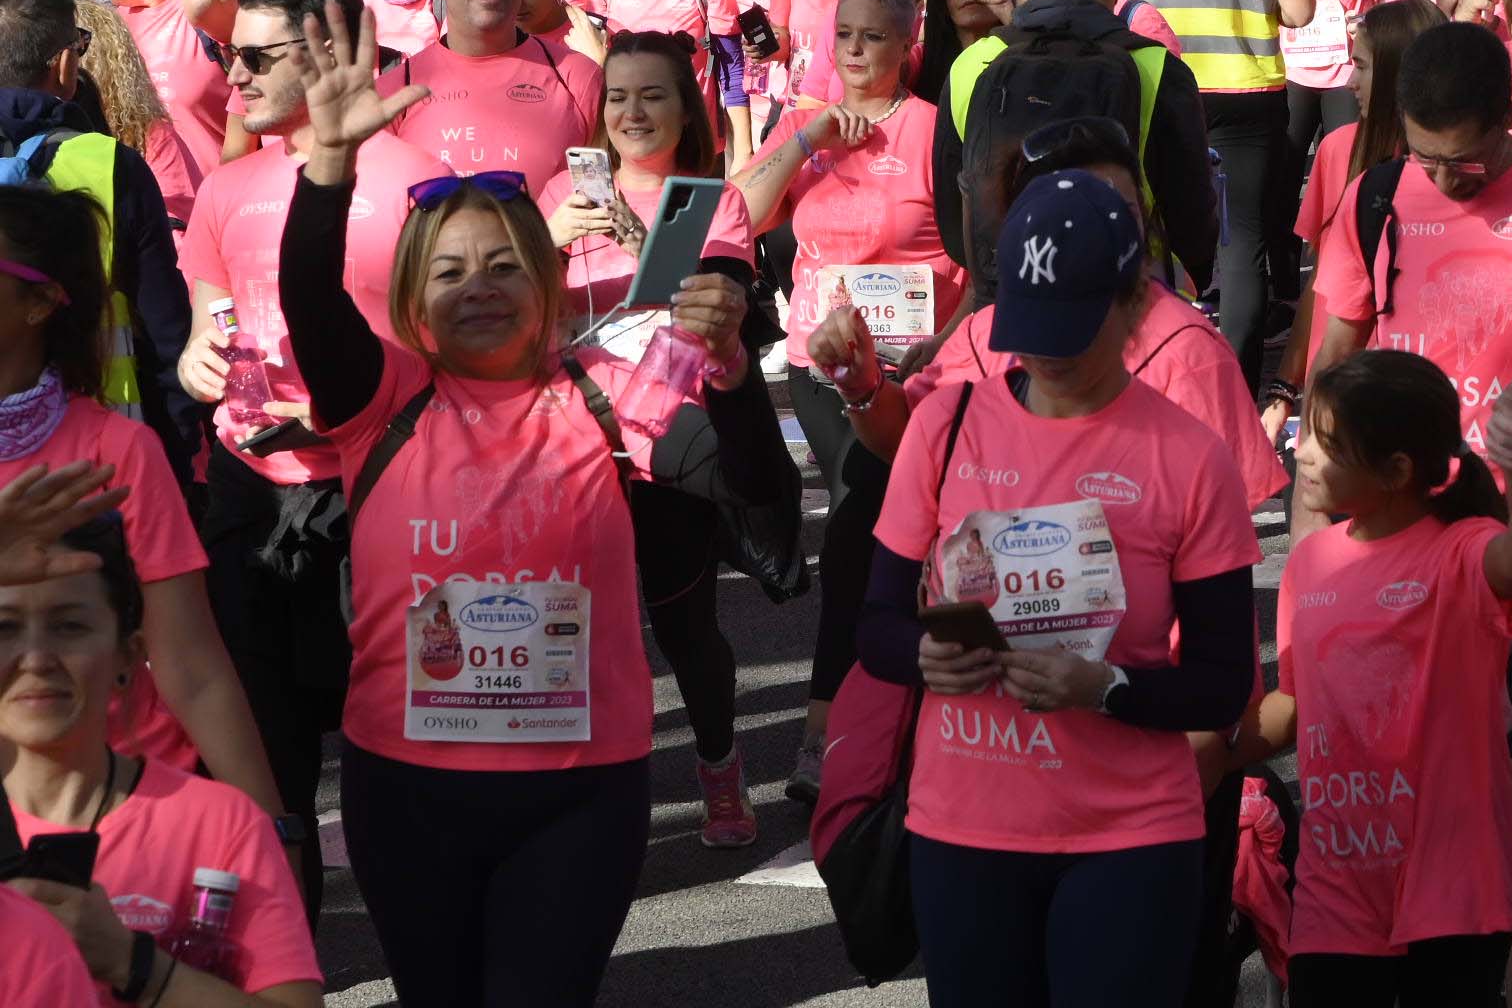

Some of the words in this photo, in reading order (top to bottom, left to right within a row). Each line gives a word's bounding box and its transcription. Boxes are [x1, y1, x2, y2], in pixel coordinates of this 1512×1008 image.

[441, 126, 477, 143] WE
[1400, 223, 1445, 237] YSHO
[855, 283, 898, 292] ASTURIANA
[1083, 481, 1137, 500] ASTURIANA
[408, 518, 457, 556] TU
[1000, 534, 1066, 552] ASTURIANA
[1003, 568, 1065, 594] 016
[466, 608, 533, 624] ASTURIANA
[545, 602, 579, 612] SUMA
[1012, 598, 1060, 616] 29089
[1020, 624, 1035, 633] DE
[1036, 621, 1051, 631] LA
[1052, 617, 1088, 630] MUJER
[1091, 613, 1115, 625] 2023
[468, 645, 530, 668] 016
[474, 675, 522, 689] 31446
[429, 695, 477, 706] CARRERA
[479, 696, 494, 706] DE
[496, 696, 510, 706] LA
[512, 696, 547, 706] MUJER
[423, 716, 479, 730] OYSHO
[521, 716, 578, 730] Santander
[938, 703, 1057, 755] SUMA
[1305, 767, 1415, 811] DORSA
[1311, 820, 1404, 860] SUMA
